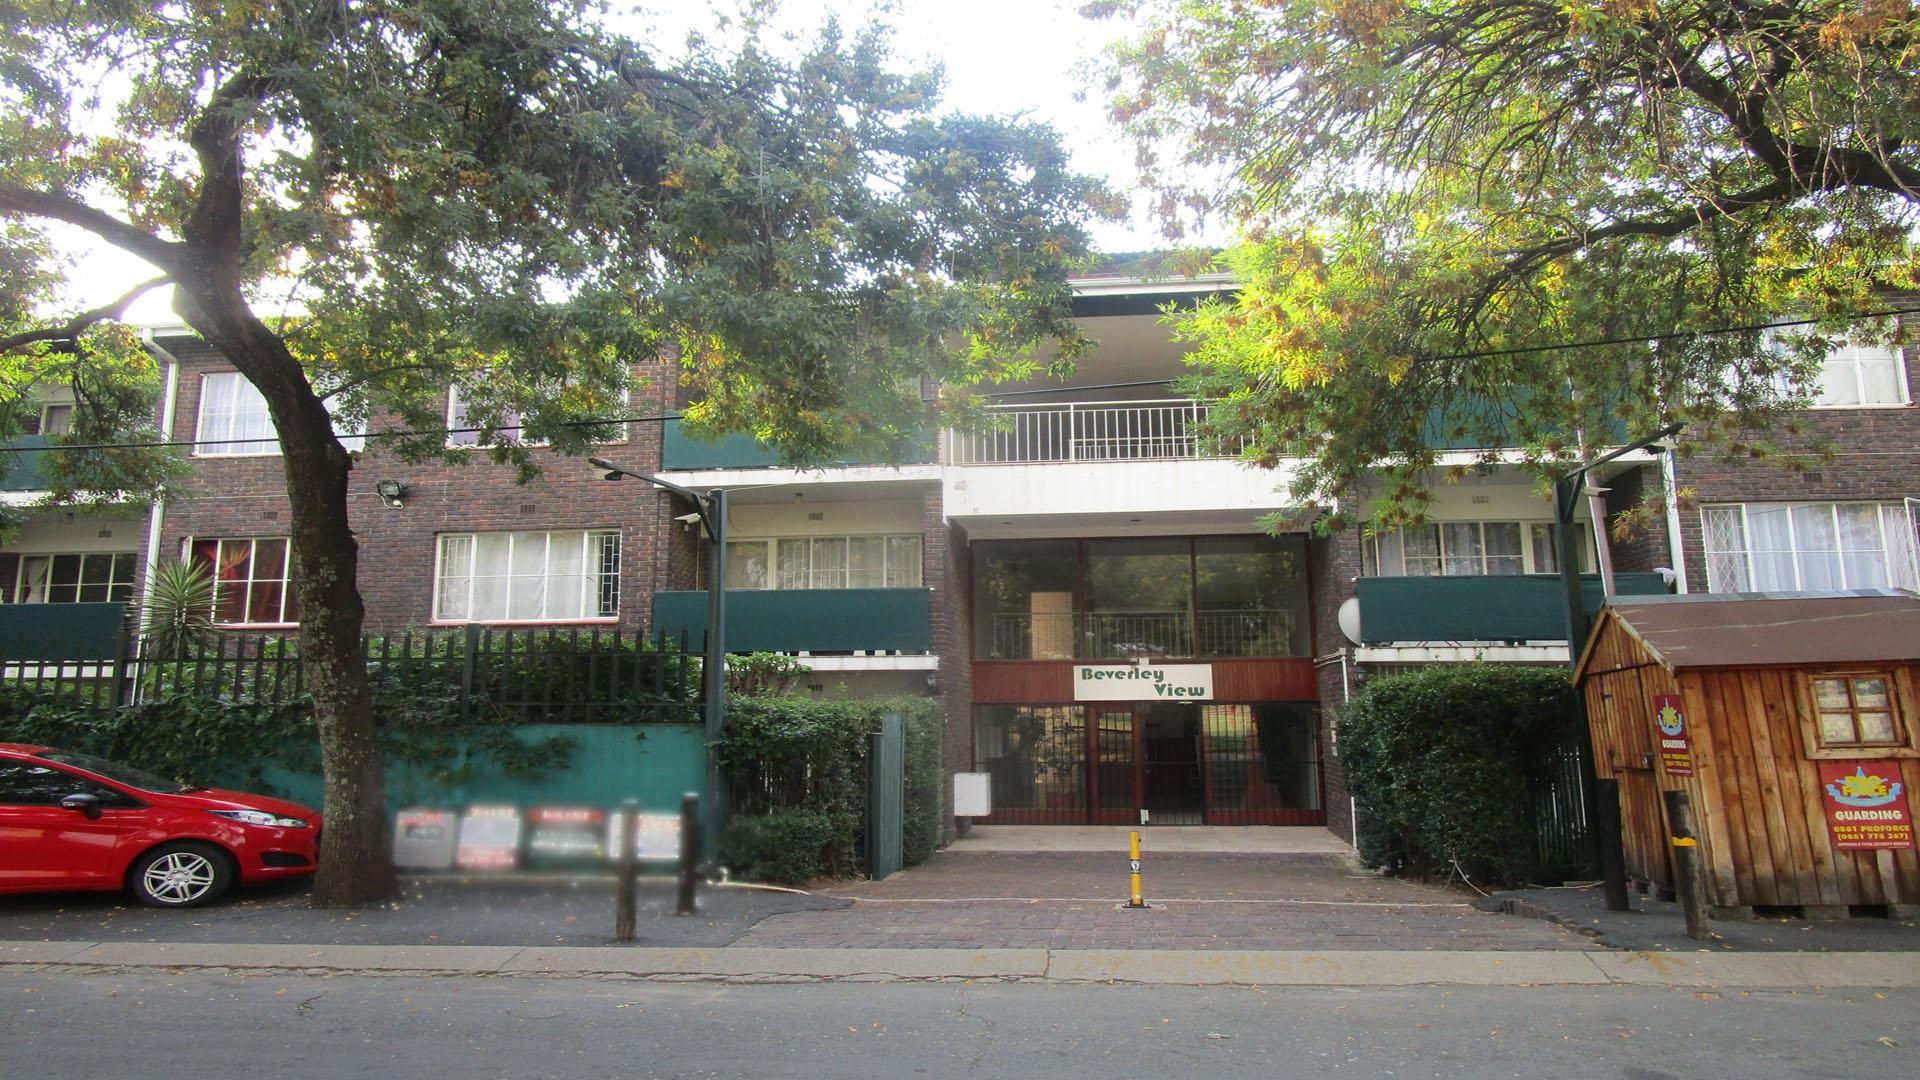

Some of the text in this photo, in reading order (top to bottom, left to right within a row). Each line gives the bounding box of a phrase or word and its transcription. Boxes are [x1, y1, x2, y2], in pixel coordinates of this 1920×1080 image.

[1081, 667, 1164, 683] Beverley
[1153, 683, 1205, 697] View
[1835, 810, 1903, 820] GUARDING
